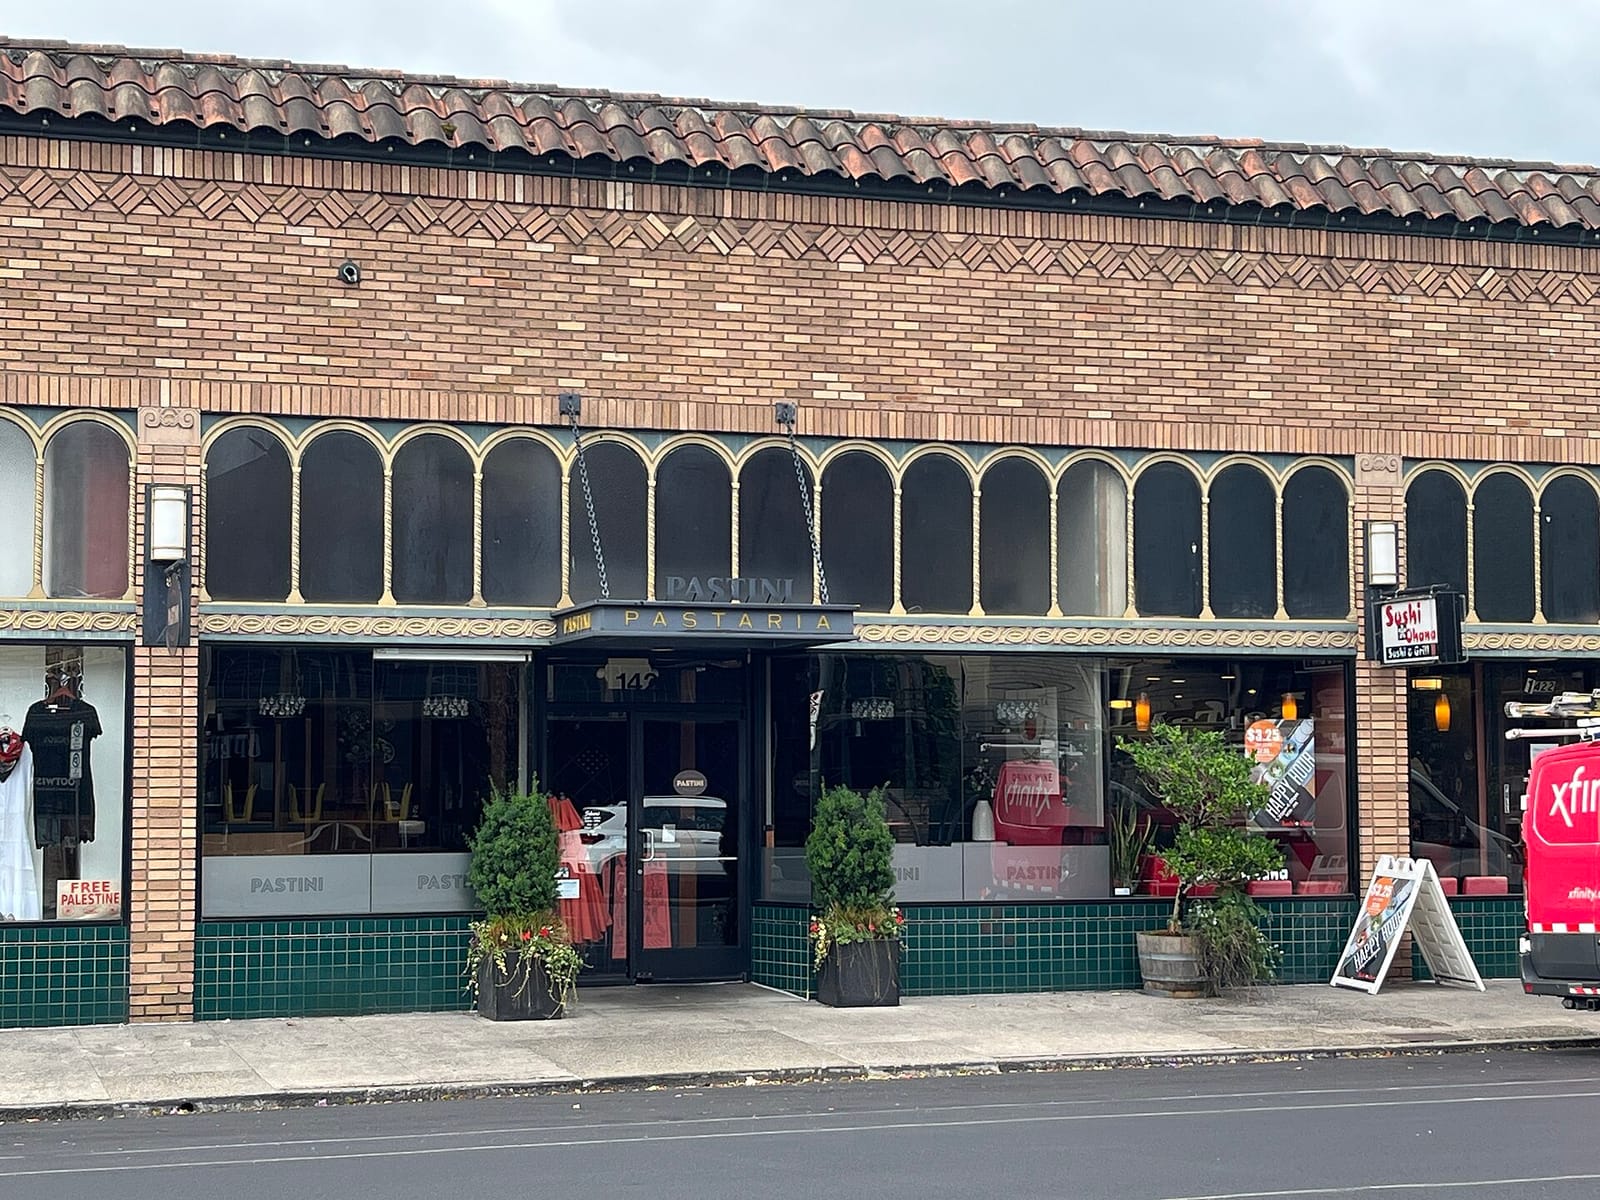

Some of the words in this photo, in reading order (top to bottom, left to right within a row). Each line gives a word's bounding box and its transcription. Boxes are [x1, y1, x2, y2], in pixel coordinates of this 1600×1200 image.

[666, 576, 795, 602] PASTINI
[624, 610, 832, 630] PASTARIA
[1385, 602, 1422, 627] Sushi
[563, 613, 592, 634] PASTINI
[1405, 628, 1436, 643] Ohana
[1388, 646, 1407, 659] Sushi
[1414, 645, 1430, 656] Grill
[1527, 679, 1555, 694] 1422
[1247, 728, 1280, 742] $3.25
[1265, 775, 1296, 819] HAPPY
[1289, 751, 1315, 786] HOUR
[1007, 865, 1067, 880] PASTIN
[71, 881, 111, 893] FREE
[250, 877, 324, 893] PASTINI
[61, 892, 120, 906] PALESTINE
[1353, 933, 1381, 970] HAPPY
[1381, 910, 1404, 942] HOUR
